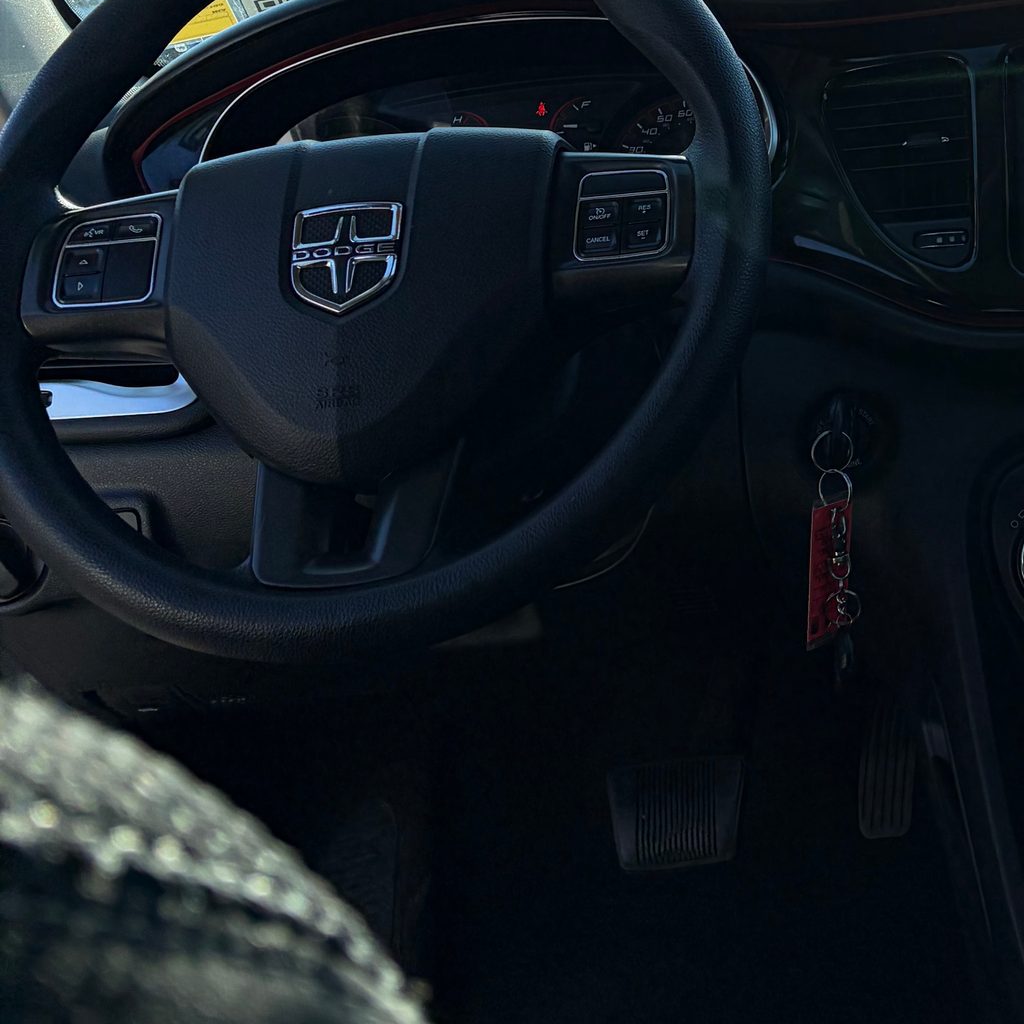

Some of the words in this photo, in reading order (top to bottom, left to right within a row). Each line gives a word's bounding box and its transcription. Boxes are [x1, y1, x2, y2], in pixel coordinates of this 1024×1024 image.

[580, 99, 592, 109] F
[656, 113, 673, 123] 50
[677, 108, 694, 118] 60
[452, 115, 463, 125] H
[641, 127, 658, 137] 40
[586, 236, 611, 245] CANCEL
[291, 241, 397, 261] DODGE
